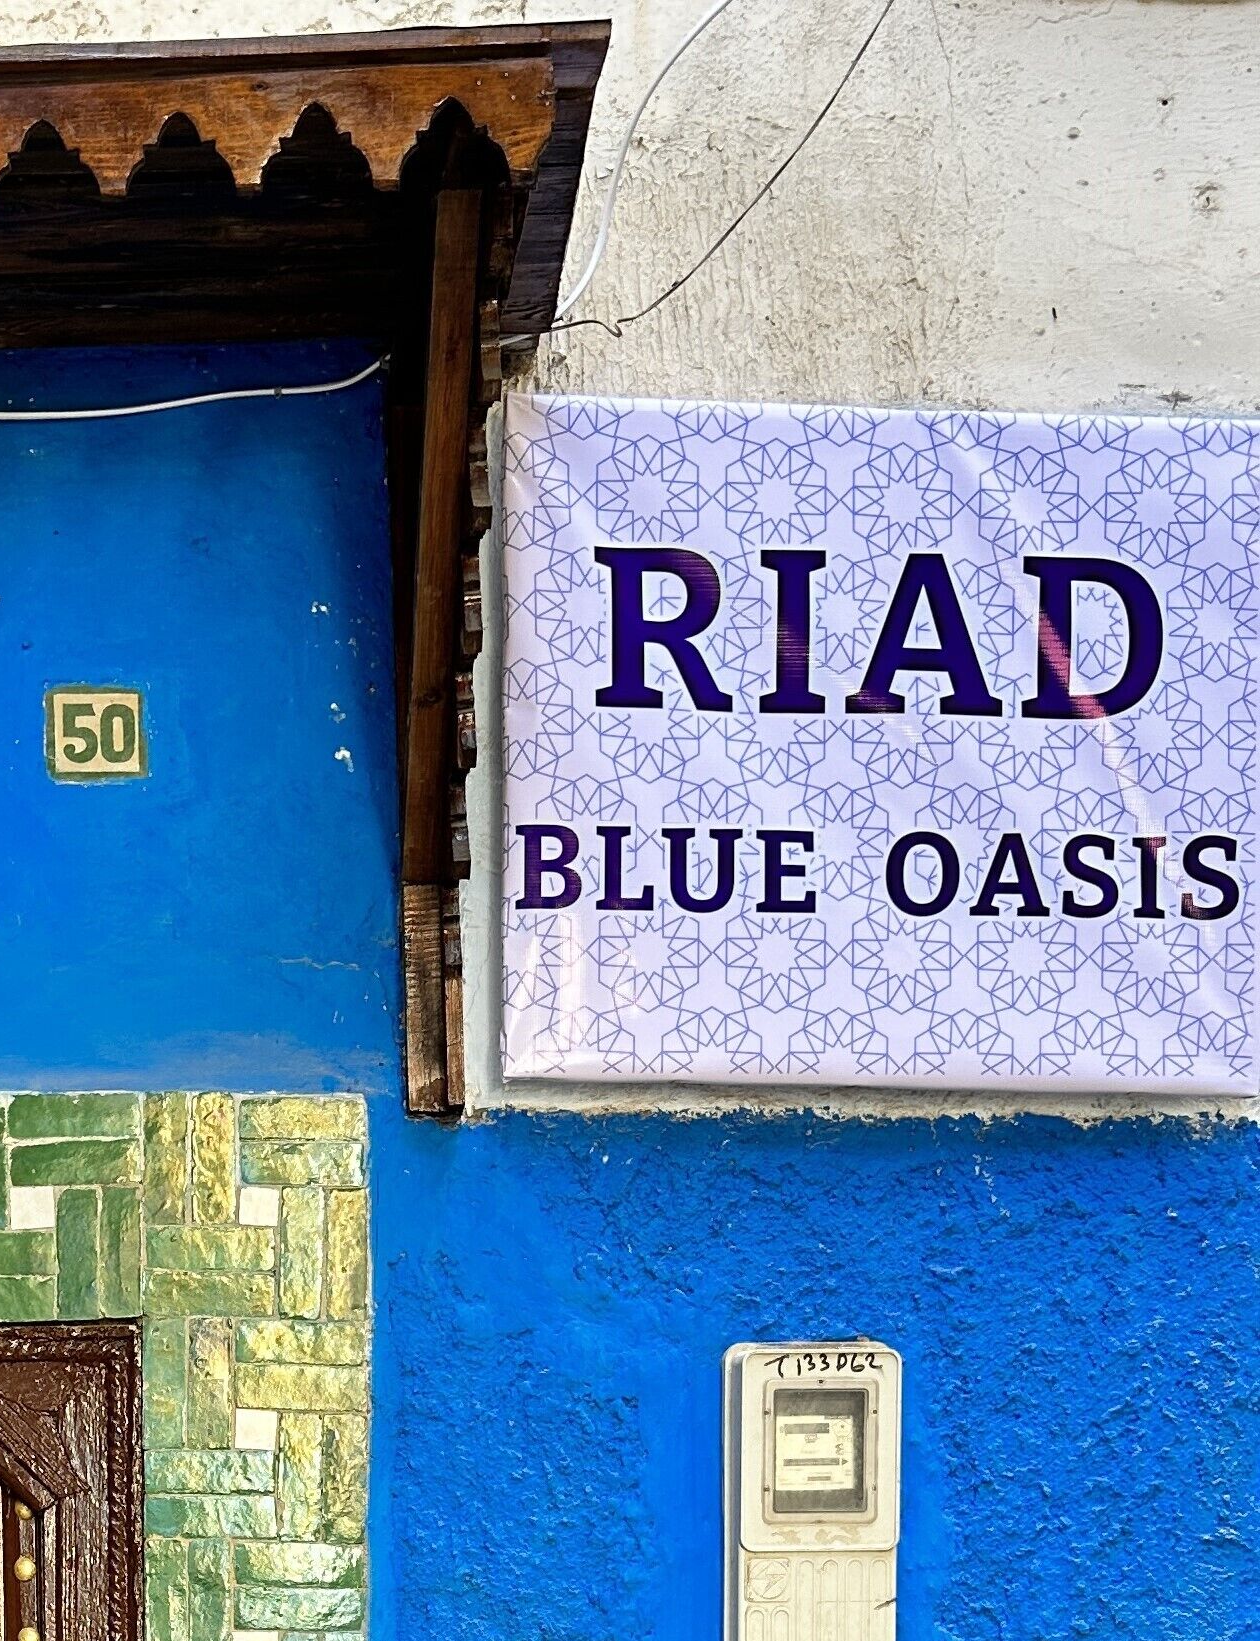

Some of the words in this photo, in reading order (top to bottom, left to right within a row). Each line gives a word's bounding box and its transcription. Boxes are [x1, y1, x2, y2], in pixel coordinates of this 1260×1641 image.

[593, 545, 1165, 720] RIAD
[62, 703, 136, 764] 50
[514, 823, 817, 914] BLUE
[884, 830, 1241, 920] OASIS
